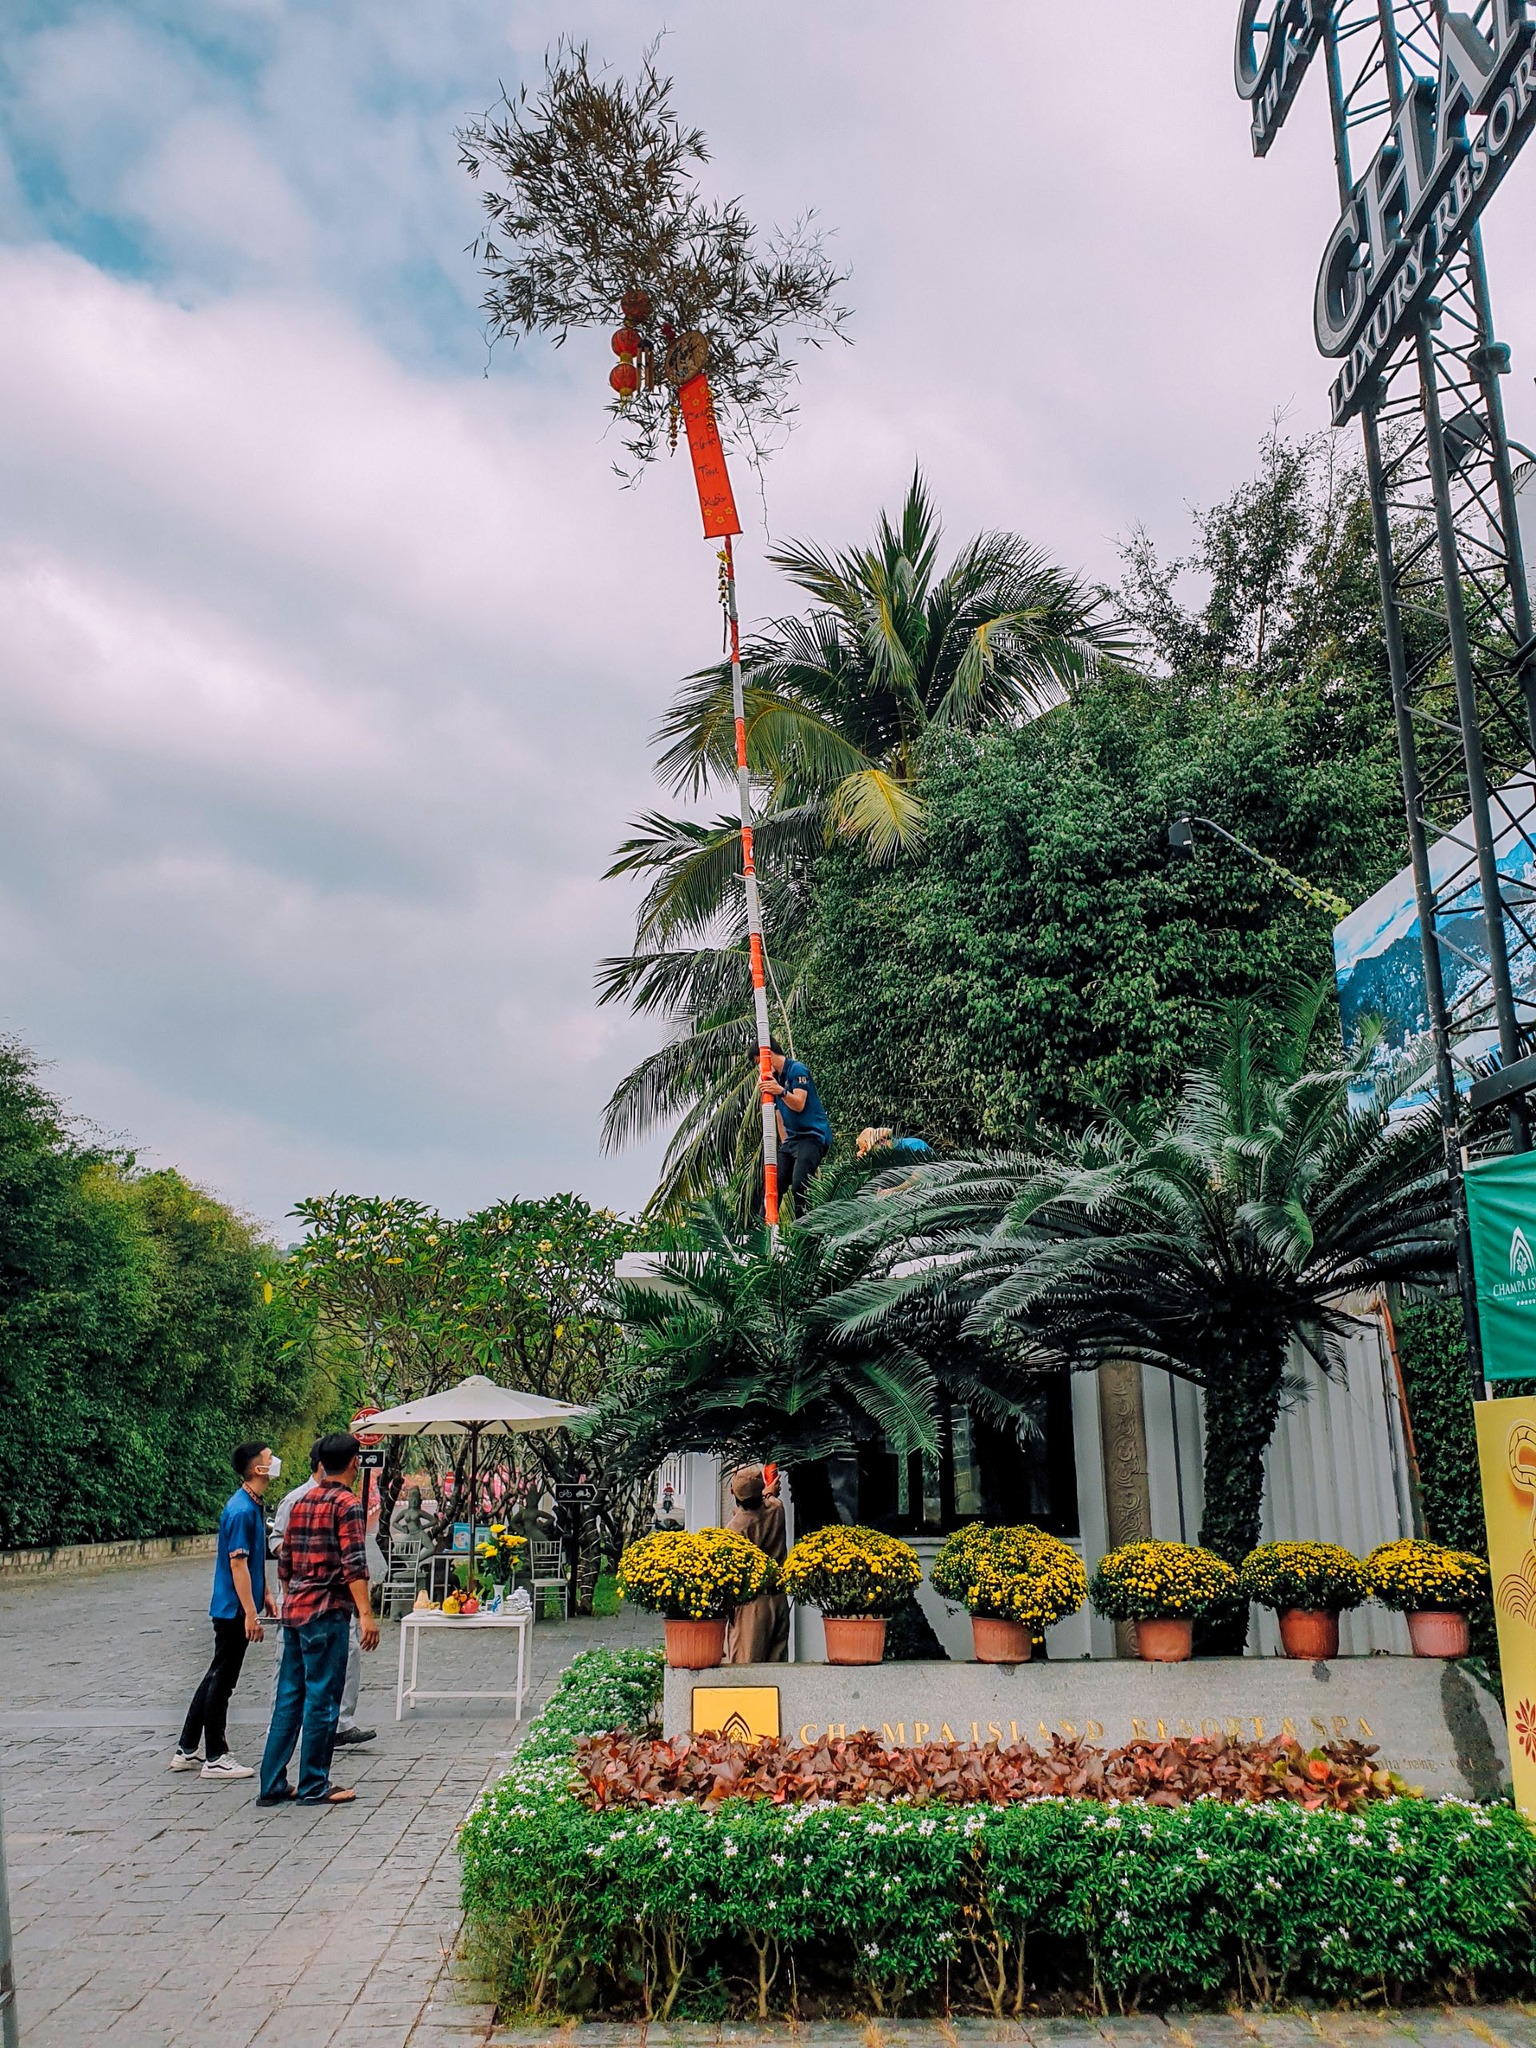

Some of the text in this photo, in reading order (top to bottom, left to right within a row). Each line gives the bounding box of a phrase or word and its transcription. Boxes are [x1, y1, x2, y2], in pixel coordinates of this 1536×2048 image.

[1314, 0, 1521, 358] CHA
[1329, 32, 1536, 422] LUXURY RESOR
[1493, 1281, 1527, 1297] CHAMPA
[1527, 1277, 1536, 1291] IS
[970, 1718, 1105, 1743] ISLAND
[1131, 1717, 1266, 1740] RESORT
[1281, 1716, 1298, 1738] &
[1309, 1714, 1374, 1739] SPA
